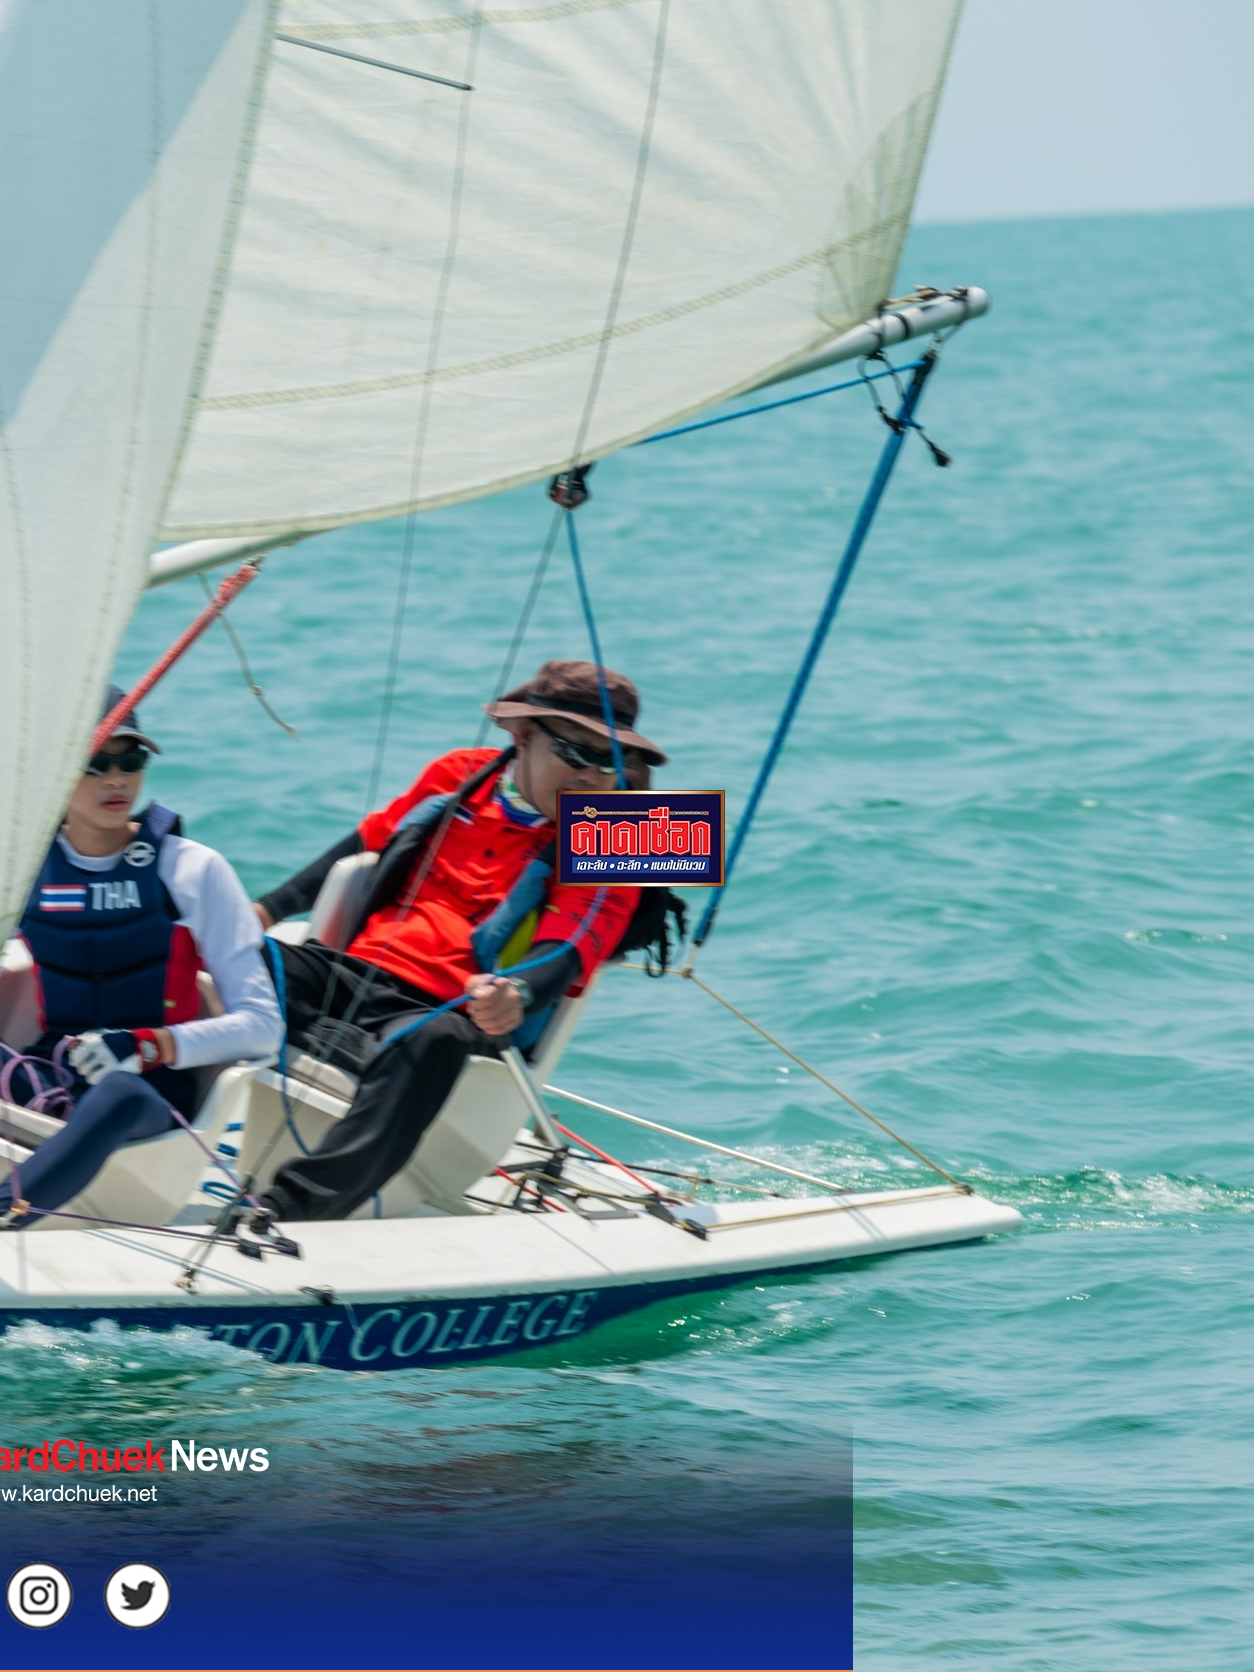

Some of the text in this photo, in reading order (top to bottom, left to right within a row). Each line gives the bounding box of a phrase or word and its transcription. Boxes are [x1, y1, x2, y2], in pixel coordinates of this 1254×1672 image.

[89, 880, 142, 911] THA
[195, 1291, 598, 1364] TON COLLEGE
